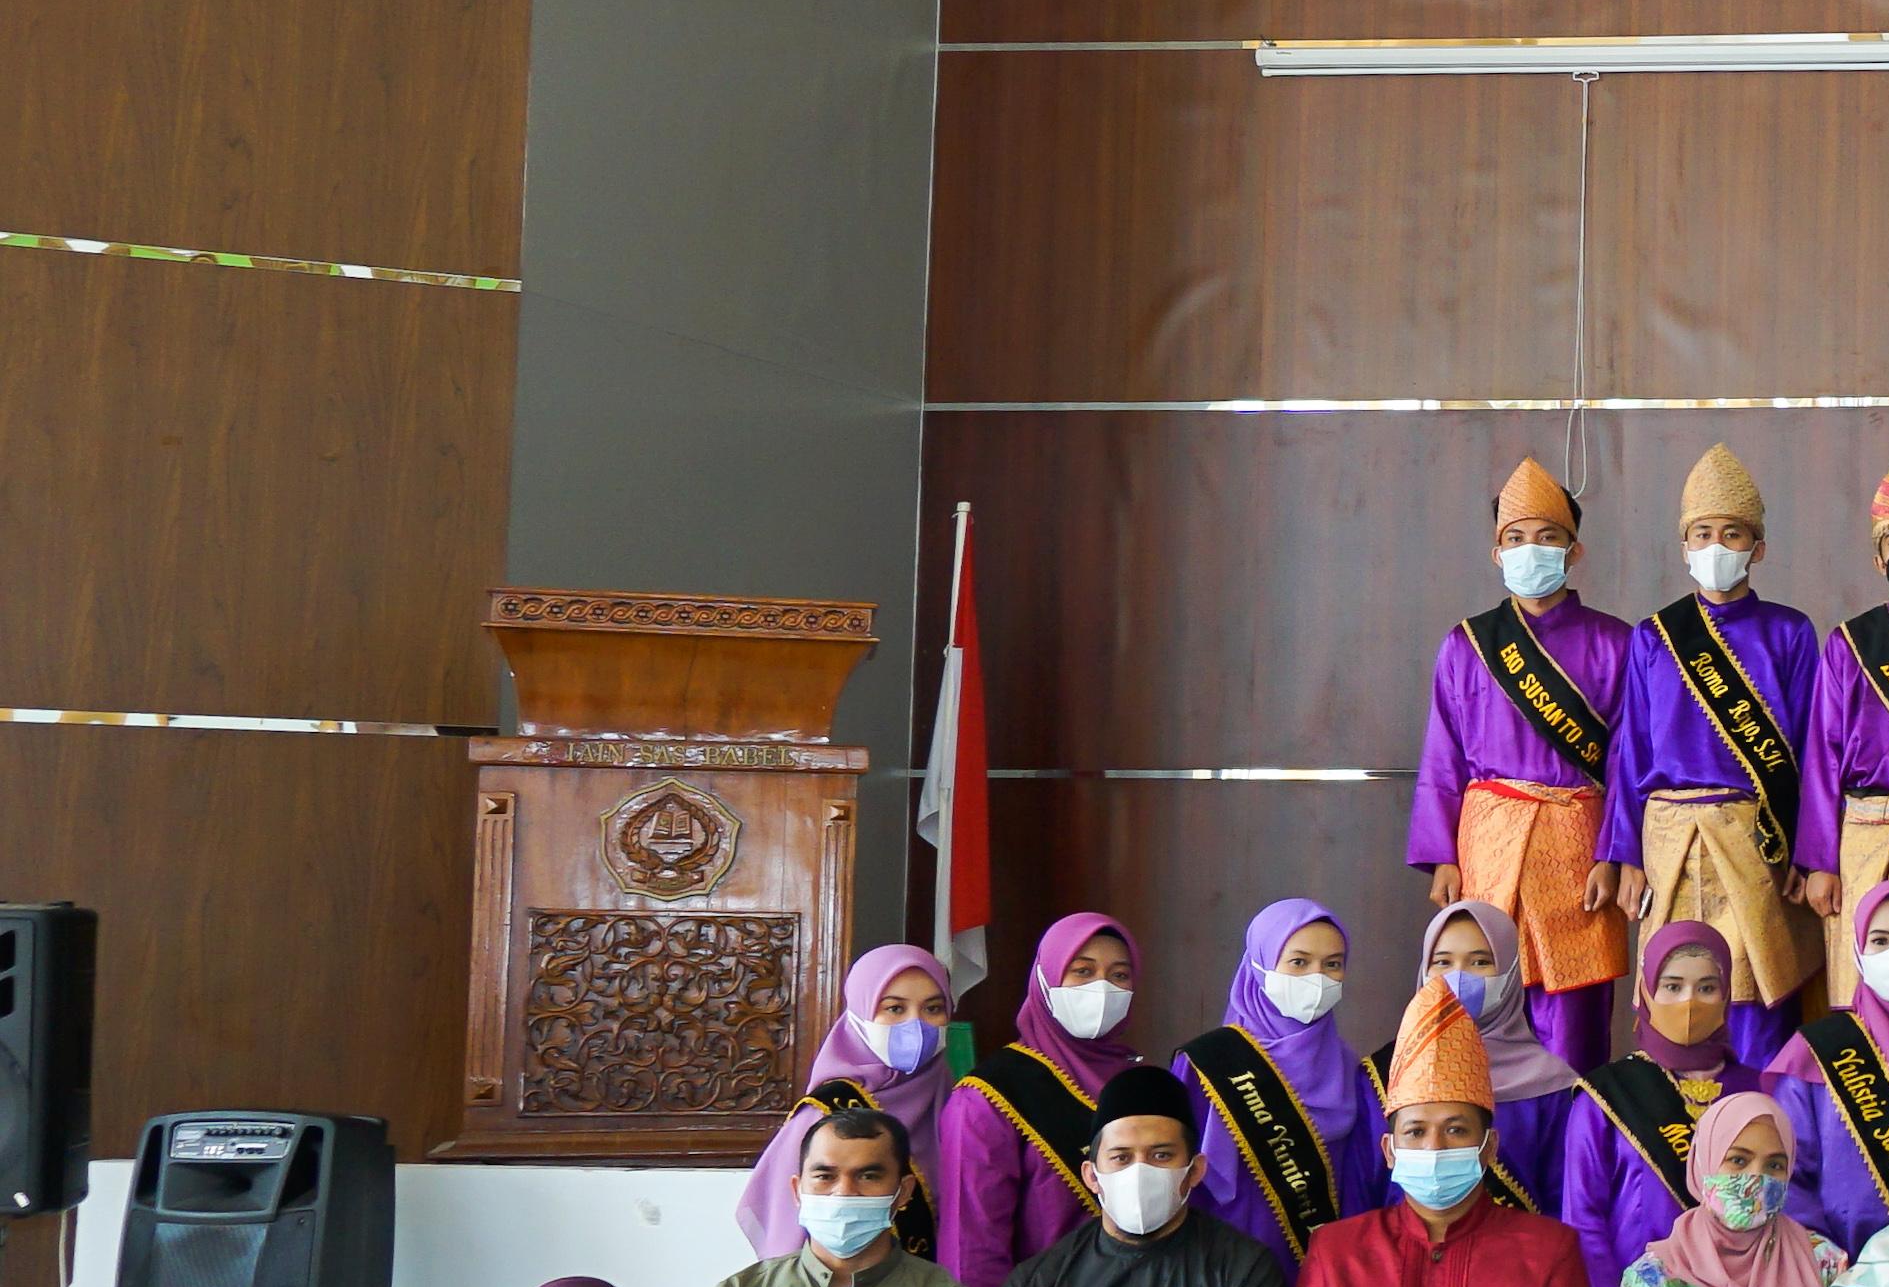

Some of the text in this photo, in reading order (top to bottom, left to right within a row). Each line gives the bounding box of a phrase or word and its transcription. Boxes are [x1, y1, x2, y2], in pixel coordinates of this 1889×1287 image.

[1500, 642, 1526, 675] EKO
[1688, 652, 1729, 699] Roma
[566, 742, 797, 766] IAIN SAS BABEL
[1230, 1070, 1274, 1125] Irma
